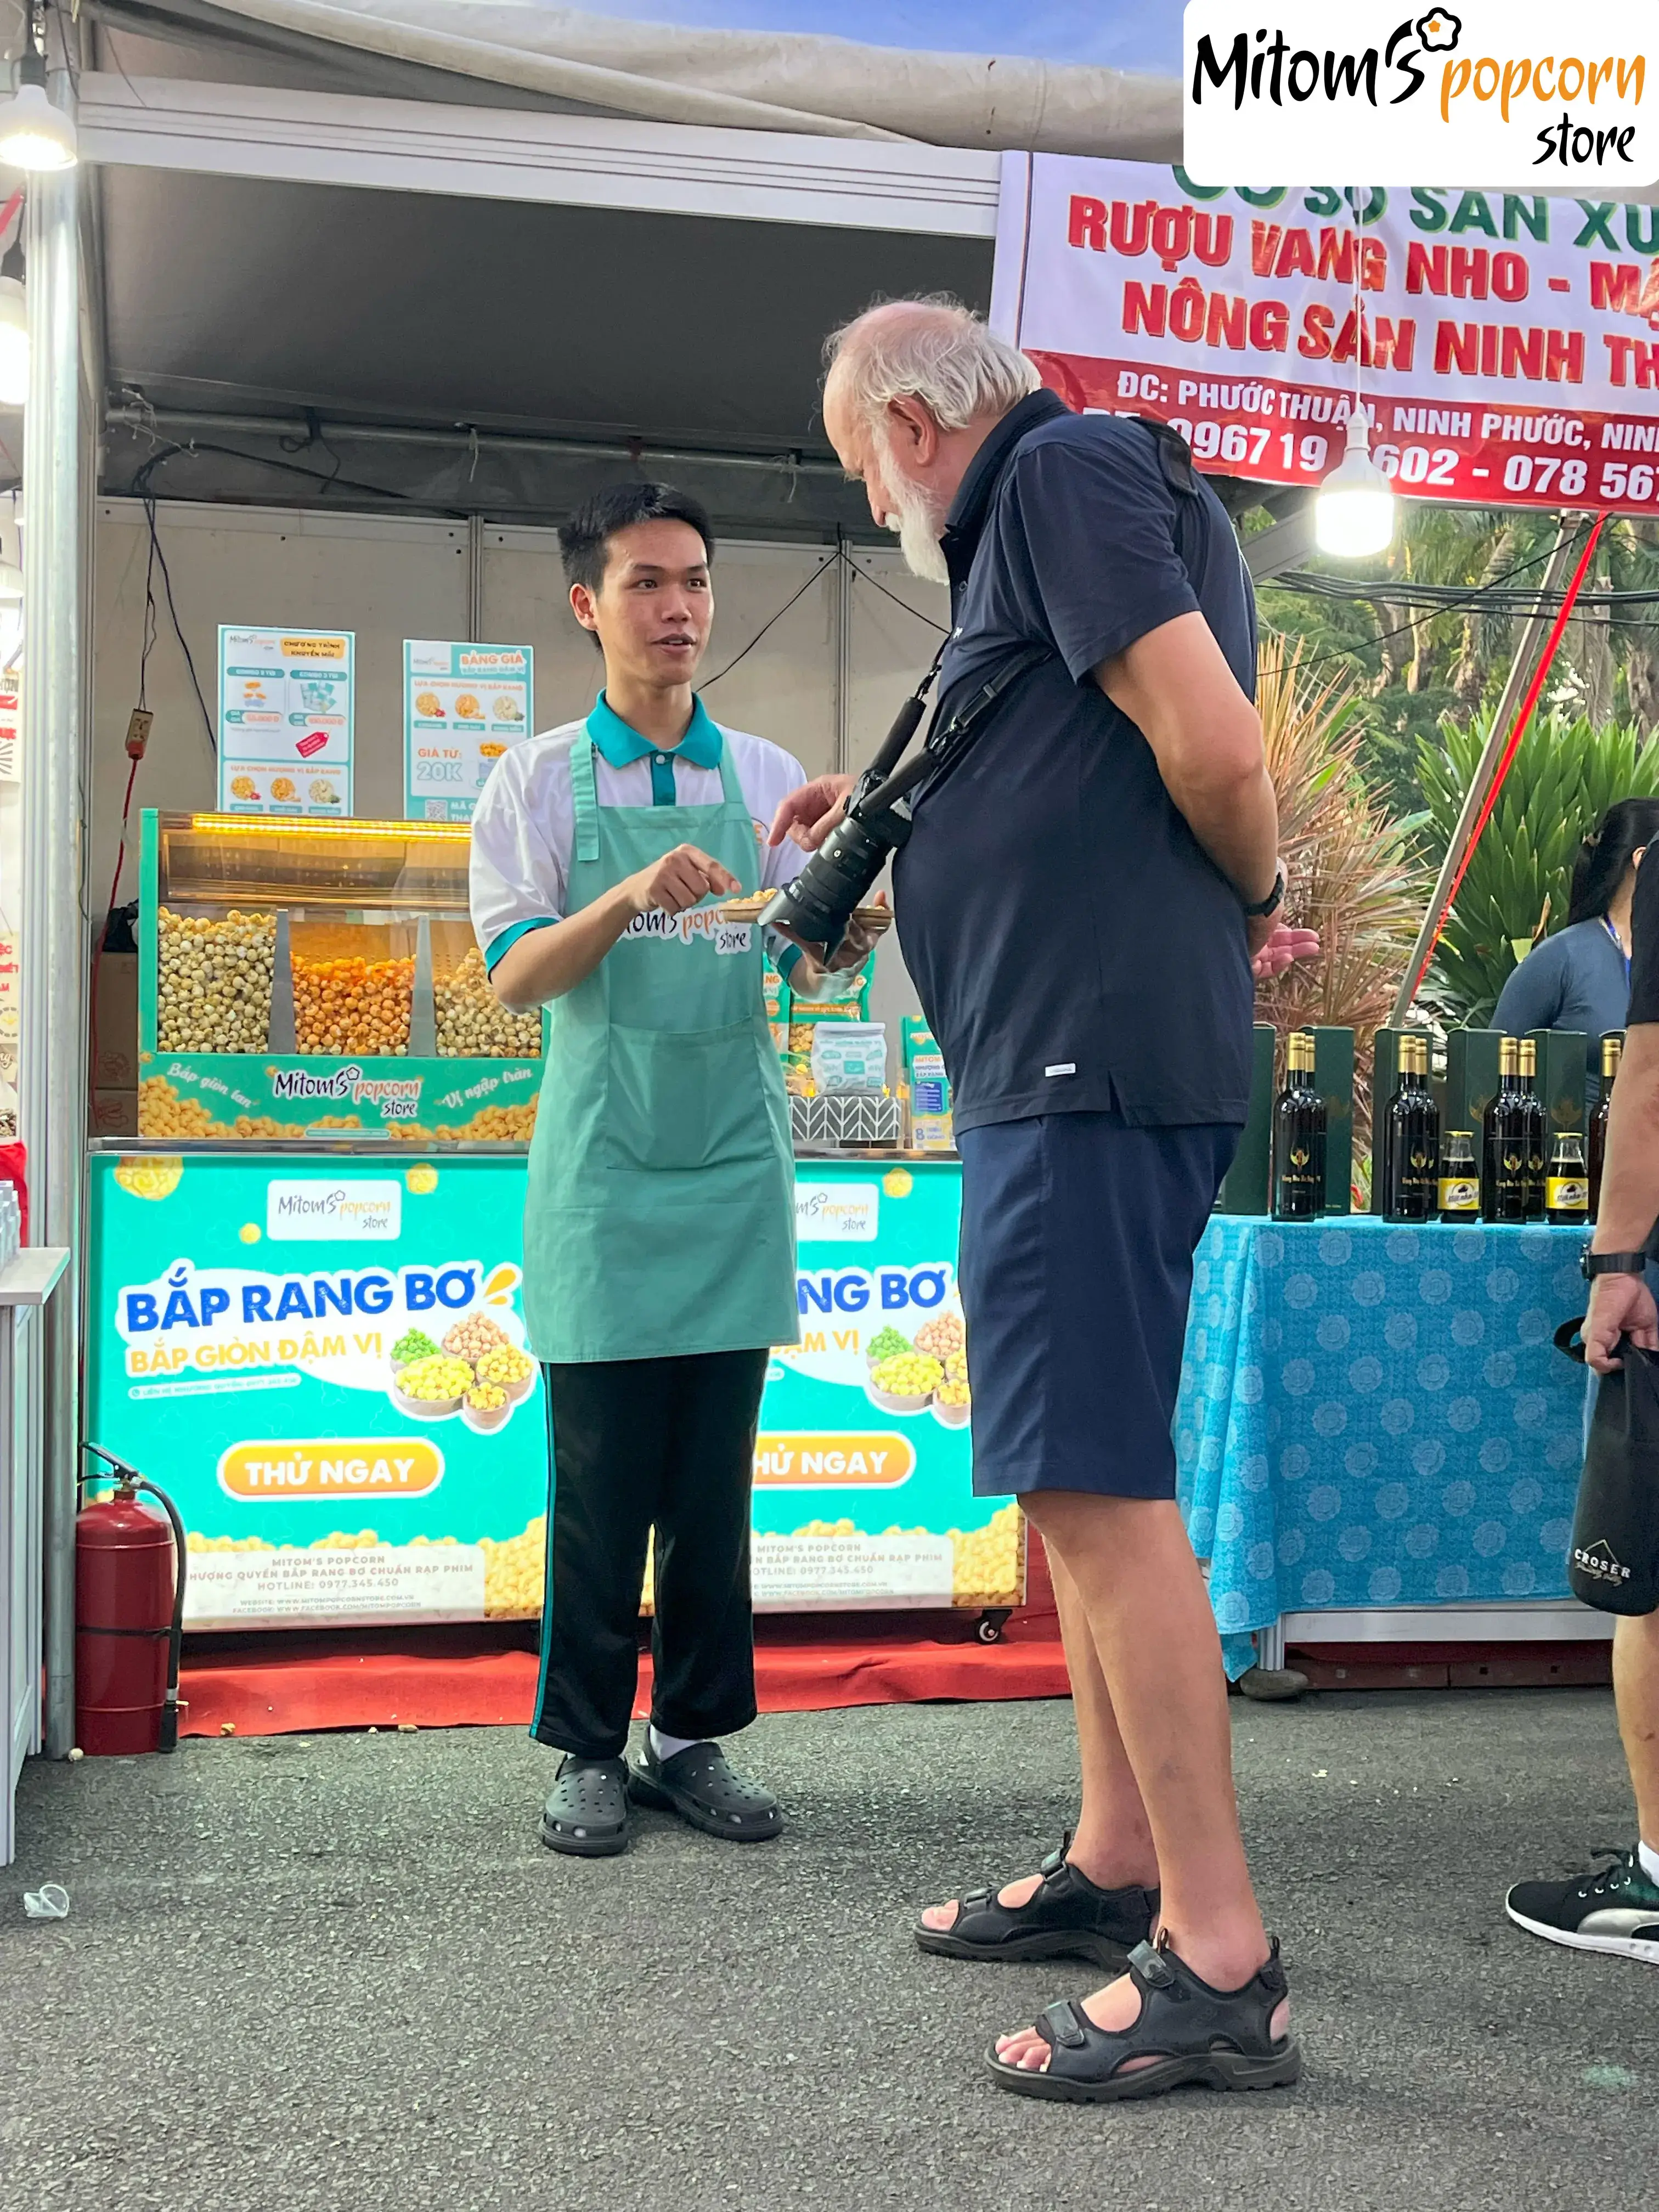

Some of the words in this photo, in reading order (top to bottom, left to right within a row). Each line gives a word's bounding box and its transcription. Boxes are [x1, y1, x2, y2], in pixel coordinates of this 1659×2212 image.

[1069, 195, 1233, 273] RƯỢU
[1251, 219, 1387, 292] VANG
[1406, 241, 1530, 301] NHO
[1122, 276, 1290, 352] NÔNG
[1298, 295, 1416, 371] SẢN
[1434, 320, 1585, 383] NINH
[1117, 371, 1169, 403] ĐC:
[1178, 379, 1277, 416] PHƯỚC
[1393, 407, 1472, 437] NINH
[1481, 413, 1591, 450] PHƯỚC,
[1601, 422, 1659, 453] NIN
[1503, 455, 1588, 496] 078
[1599, 462, 1659, 501] 56
[418, 747, 439, 758] GIÁ
[417, 761, 463, 782] 20K
[628, 911, 678, 934] om's
[682, 909, 730, 940] popc
[720, 930, 747, 950] store
[354, 1081, 419, 1102] popcorn
[383, 1099, 416, 1115] store
[340, 1201, 391, 1221] popcorn
[362, 1215, 388, 1229] store
[127, 1267, 230, 1332] BẮP
[242, 1276, 393, 1323] RANG
[405, 1268, 476, 1311] BƠ
[881, 1269, 946, 1310] BƠ
[131, 1337, 189, 1373] BẮP
[195, 1336, 270, 1367] GIÒN
[277, 1330, 347, 1364] ĐẬM
[353, 1332, 382, 1359] VỊ
[832, 1329, 859, 1356] VỊ
[245, 1451, 313, 1486] THỬ
[319, 1459, 415, 1484] NGAY
[800, 1451, 888, 1475] NGAY
[757, 1544, 804, 1553] MITOM'S
[808, 1544, 861, 1553] POPCORN
[793, 1555, 823, 1564] RANG
[915, 1553, 943, 1562] PHIM
[272, 1557, 323, 1566] MITOM'S
[328, 1556, 385, 1565] POPCORN
[312, 1568, 345, 1577] RANG
[444, 1564, 473, 1573] PHIM
[1575, 1548, 1631, 1578] CROSER
[258, 1581, 315, 1591] HOTLINE:
[319, 1578, 399, 1589] 0977.345.450
